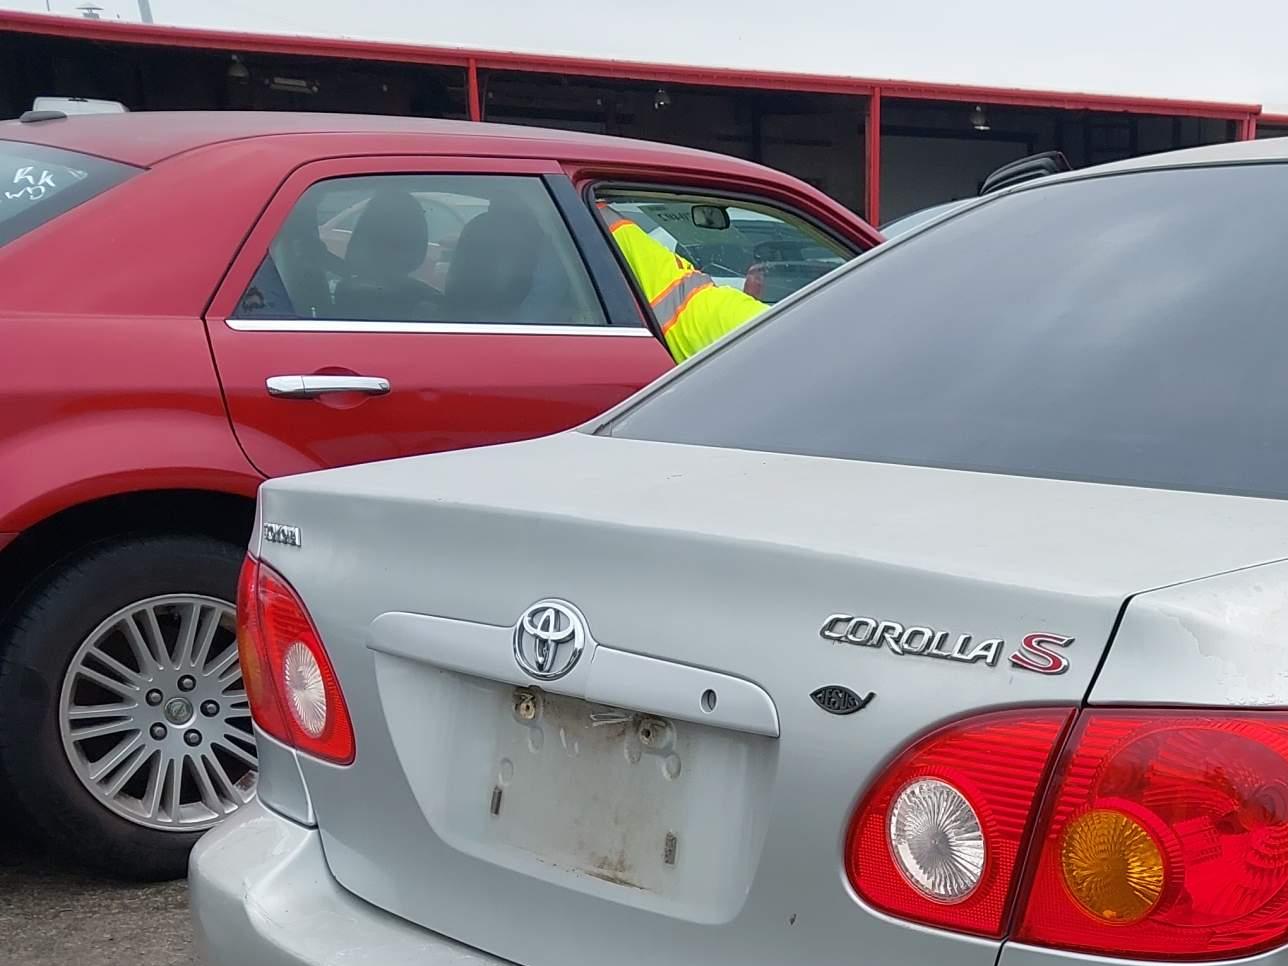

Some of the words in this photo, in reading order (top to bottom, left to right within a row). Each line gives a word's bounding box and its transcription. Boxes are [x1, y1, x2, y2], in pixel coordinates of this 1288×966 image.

[820, 614, 1005, 667] COROLLA
[1008, 632, 1075, 675] S
[816, 687, 860, 711] JESUS
